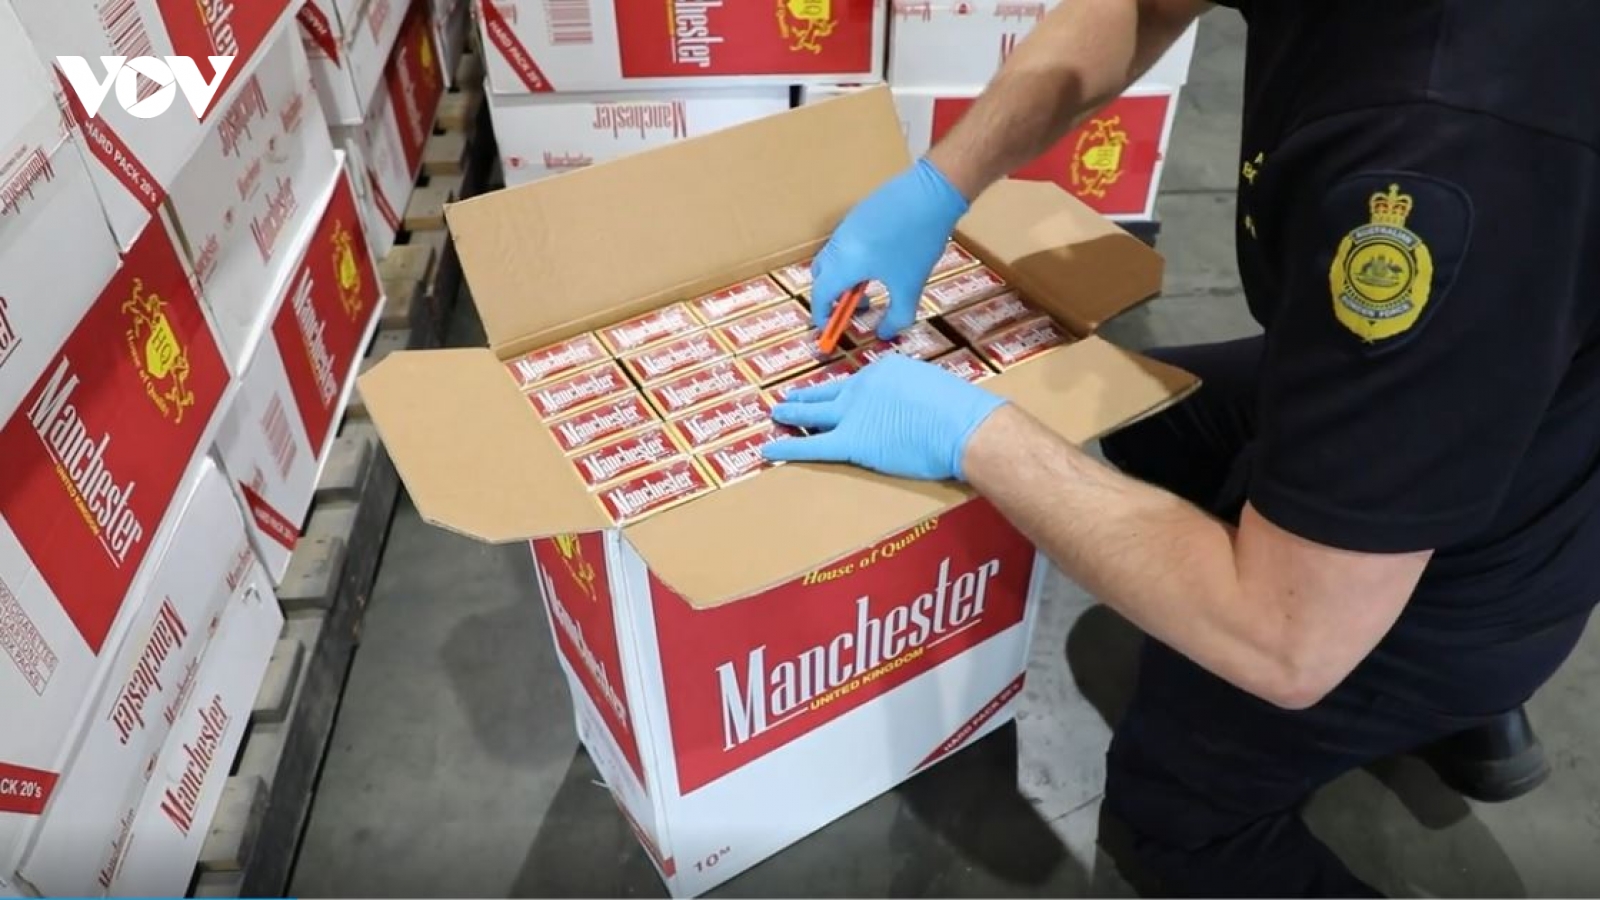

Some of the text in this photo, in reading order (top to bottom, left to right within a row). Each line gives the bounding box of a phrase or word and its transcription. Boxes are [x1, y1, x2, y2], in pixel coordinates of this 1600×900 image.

[673, 0, 725, 68] hester
[594, 101, 687, 138] Manchester
[113, 150, 143, 184] PACK
[515, 342, 591, 381] Manchester
[635, 340, 711, 382] Manchester
[536, 369, 616, 412] Manchester
[659, 367, 737, 415] Manchester
[559, 399, 641, 448] Manchester
[27, 354, 143, 563] Manchester
[582, 434, 666, 482] Manchester
[607, 465, 695, 517] Manchester
[802, 515, 940, 587] House of Quality
[112, 594, 188, 746] Manchester
[716, 557, 1001, 752] Manchester
[810, 647, 925, 711] UNITED KINGDOM
[0, 778, 42, 798] CK 20's
[160, 695, 229, 838] Manchester
